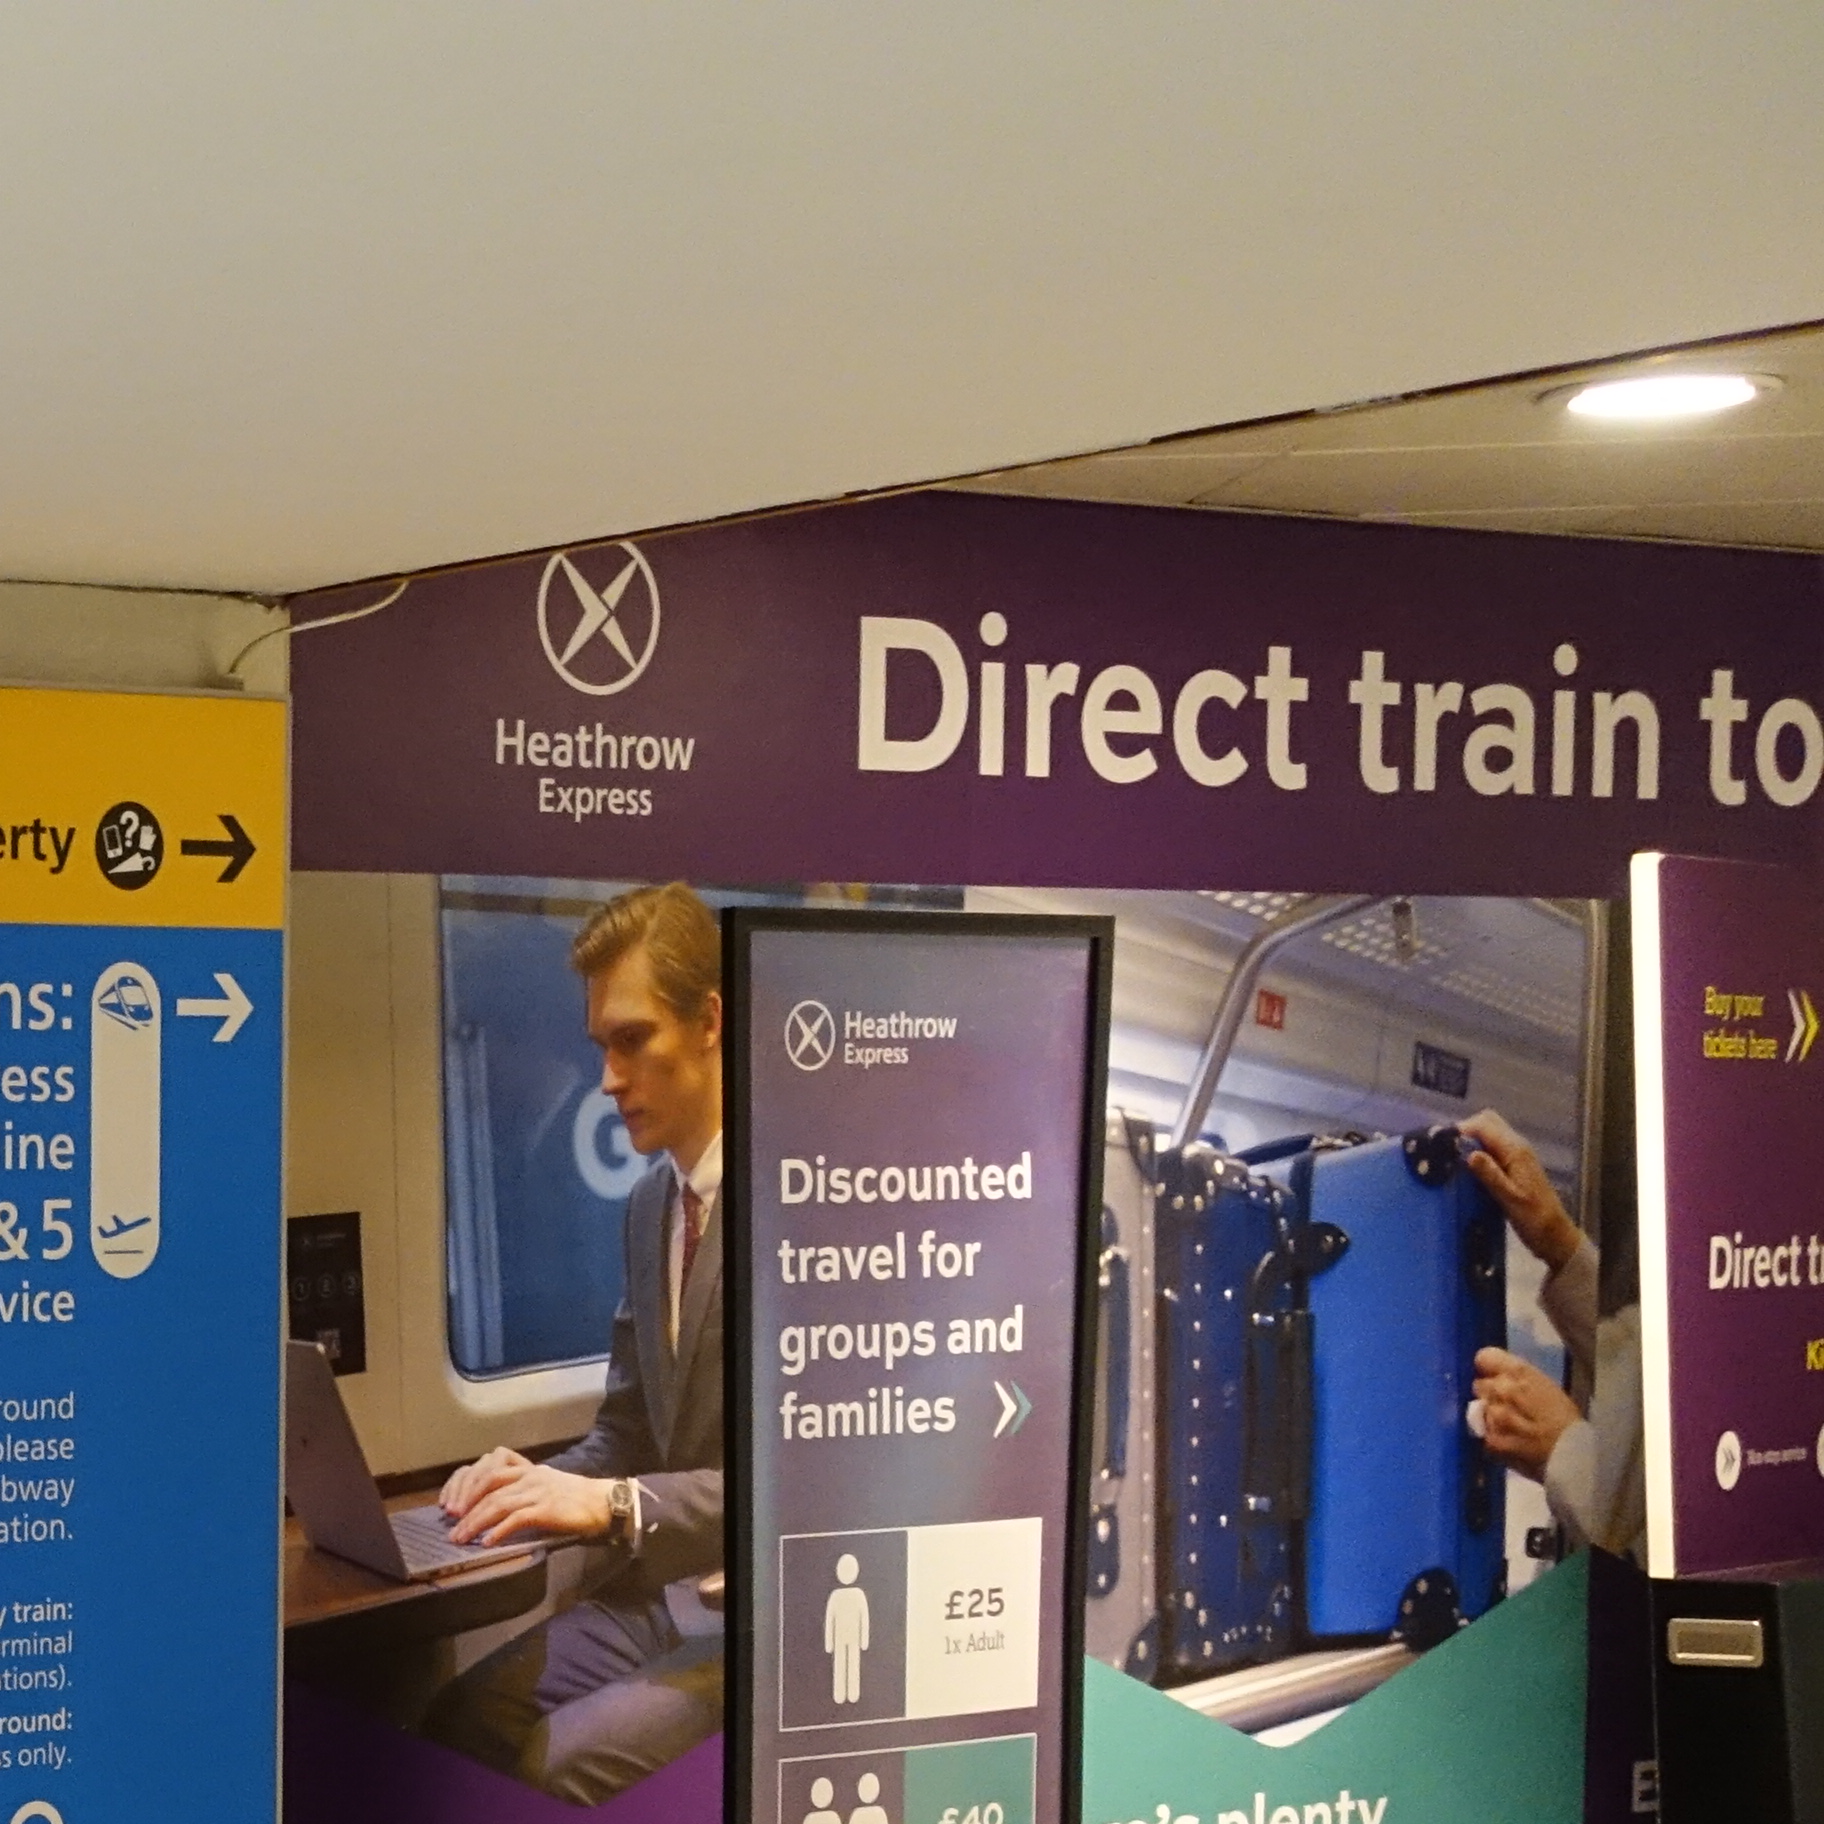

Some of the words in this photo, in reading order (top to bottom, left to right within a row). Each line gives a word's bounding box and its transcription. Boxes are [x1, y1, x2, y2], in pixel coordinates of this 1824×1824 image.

[858, 612, 1308, 790] Direct
[1349, 644, 1659, 799] train
[1700, 670, 1824, 806] to
[497, 719, 695, 770] Heathrow
[540, 778, 652, 822] Express
[1704, 985, 1732, 1021] Buy
[1733, 995, 1765, 1021] your
[845, 1011, 957, 1038] Heathrow
[1703, 1028, 1747, 1058] tickets
[1748, 1029, 1778, 1059] here
[845, 1043, 908, 1068] Express
[782, 1151, 1032, 1203] Discounted
[778, 1232, 905, 1283] travel
[919, 1230, 981, 1277] for
[1709, 1231, 1802, 1289] Direct
[780, 1321, 936, 1375] groups
[948, 1304, 1023, 1354] and
[780, 1386, 956, 1439] families
[13, 1598, 72, 1623] train:
[945, 1588, 1004, 1620] £25
[965, 1630, 1004, 1653] Adult
[18, 1742, 71, 1769] only.
